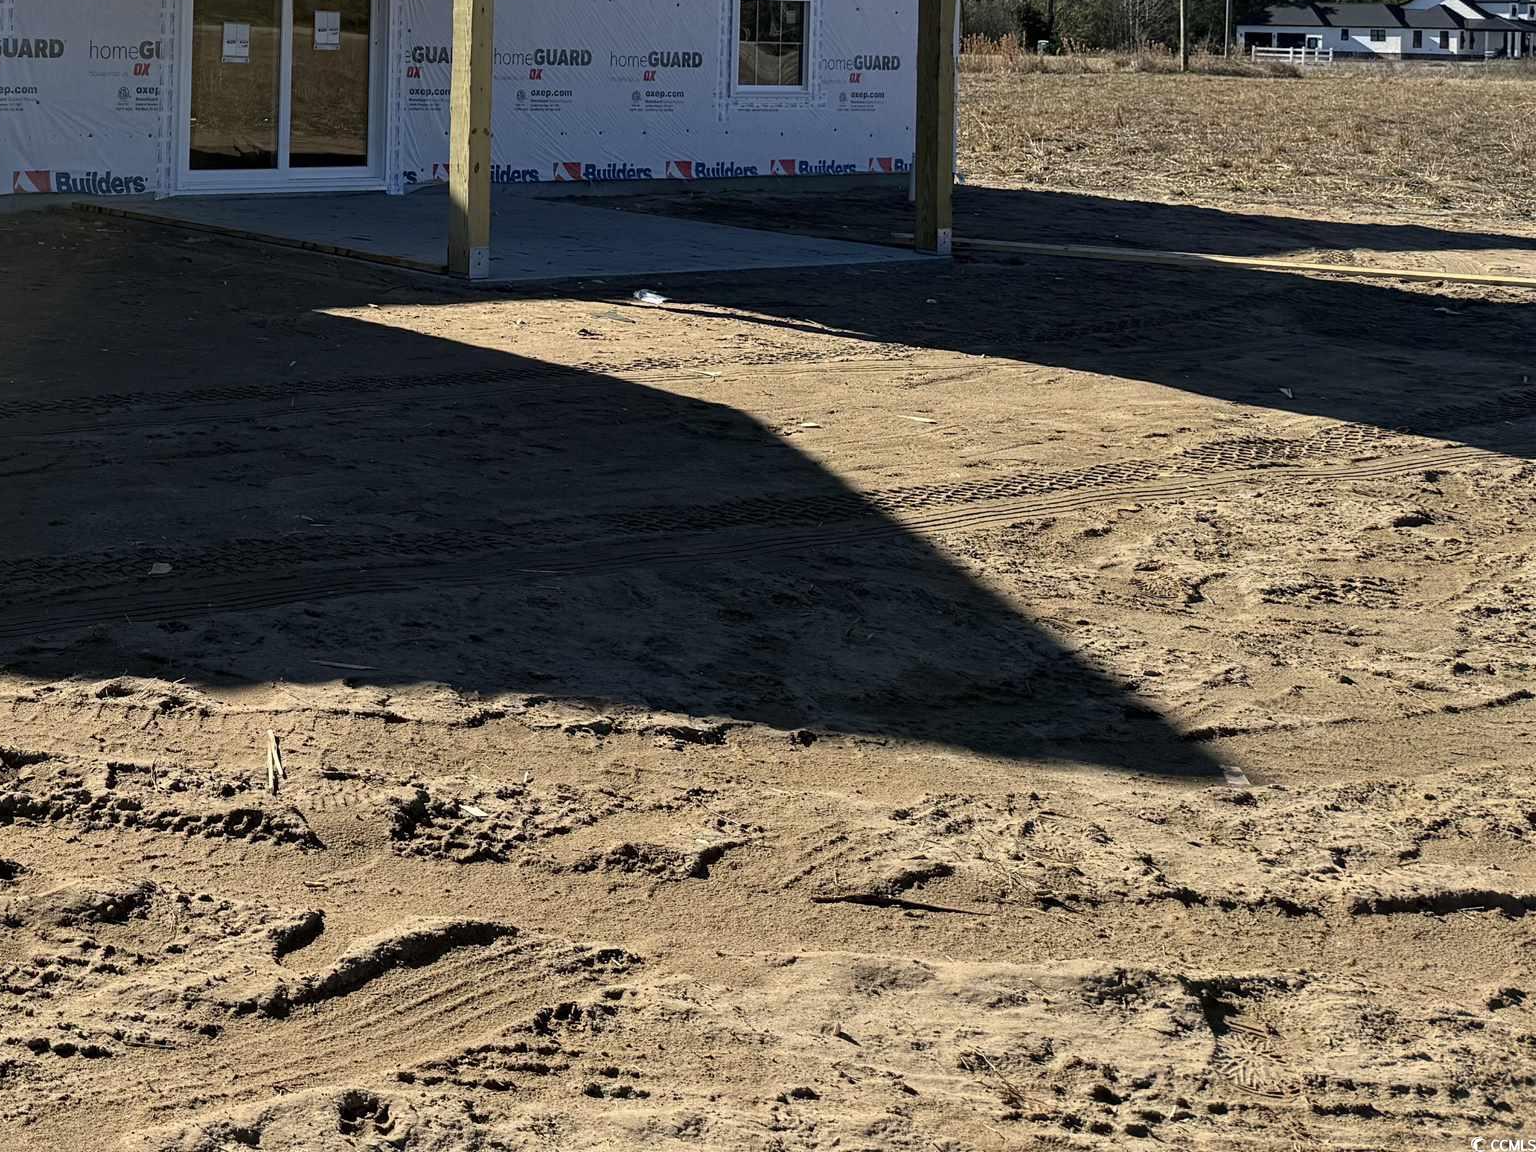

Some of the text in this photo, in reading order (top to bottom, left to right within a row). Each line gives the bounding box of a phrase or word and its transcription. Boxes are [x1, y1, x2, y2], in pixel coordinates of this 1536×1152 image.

[494, 48, 593, 66] homeGUARD
[610, 50, 703, 68] homeGUARD
[134, 63, 150, 76] OX
[529, 68, 543, 80] OX
[643, 70, 656, 82] OX
[530, 89, 573, 98] oxep.com
[584, 163, 652, 181] Builders
[55, 171, 146, 195] Builders
